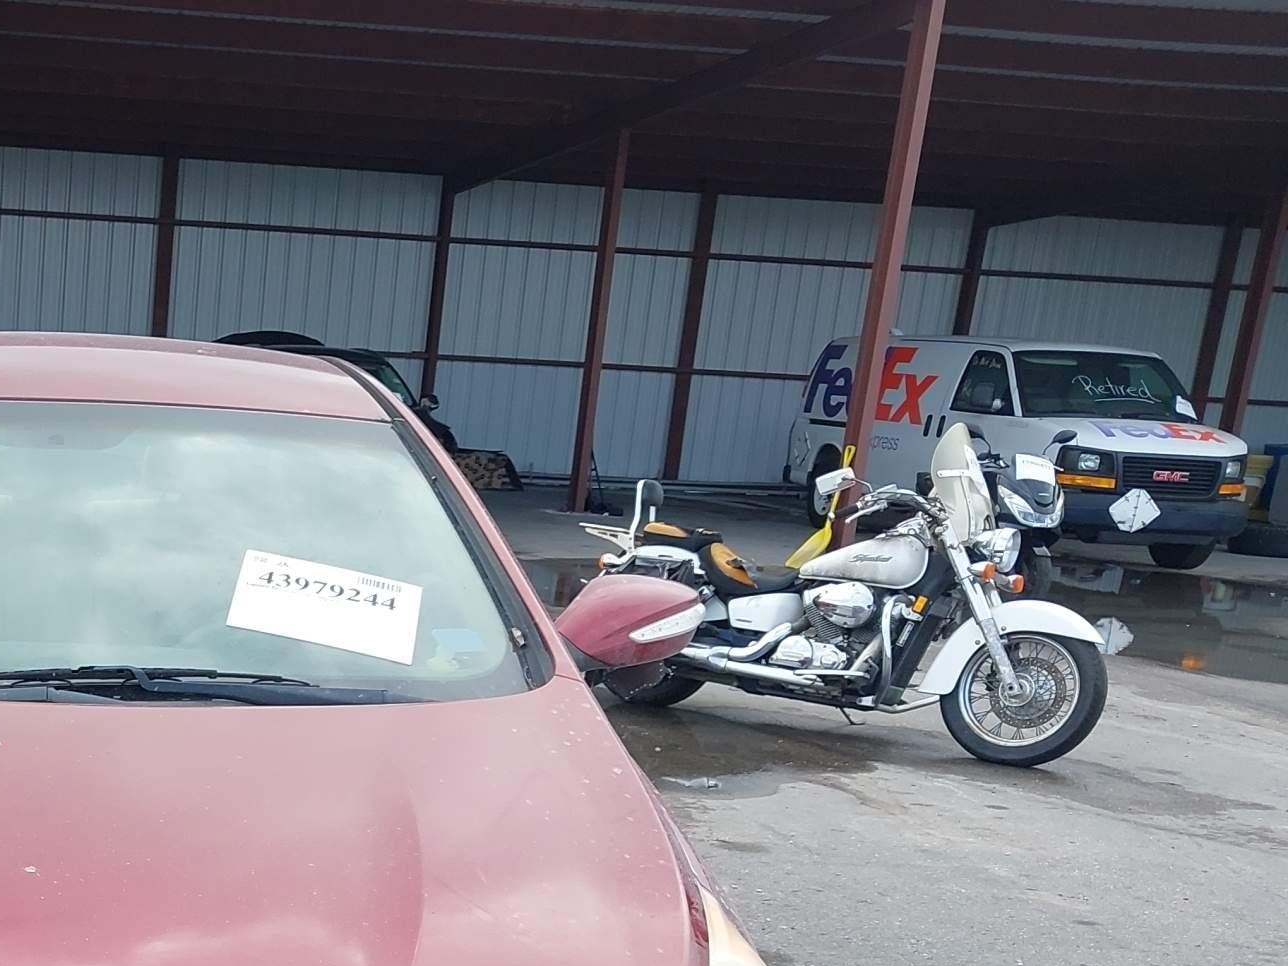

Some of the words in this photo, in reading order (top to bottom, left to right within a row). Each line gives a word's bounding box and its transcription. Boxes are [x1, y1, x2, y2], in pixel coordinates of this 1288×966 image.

[804, 345, 939, 425] FeEx
[1072, 375, 1156, 400] Retired
[1089, 420, 1226, 444] FedEx
[1152, 470, 1191, 483] GMC
[258, 571, 397, 611] 43979244
